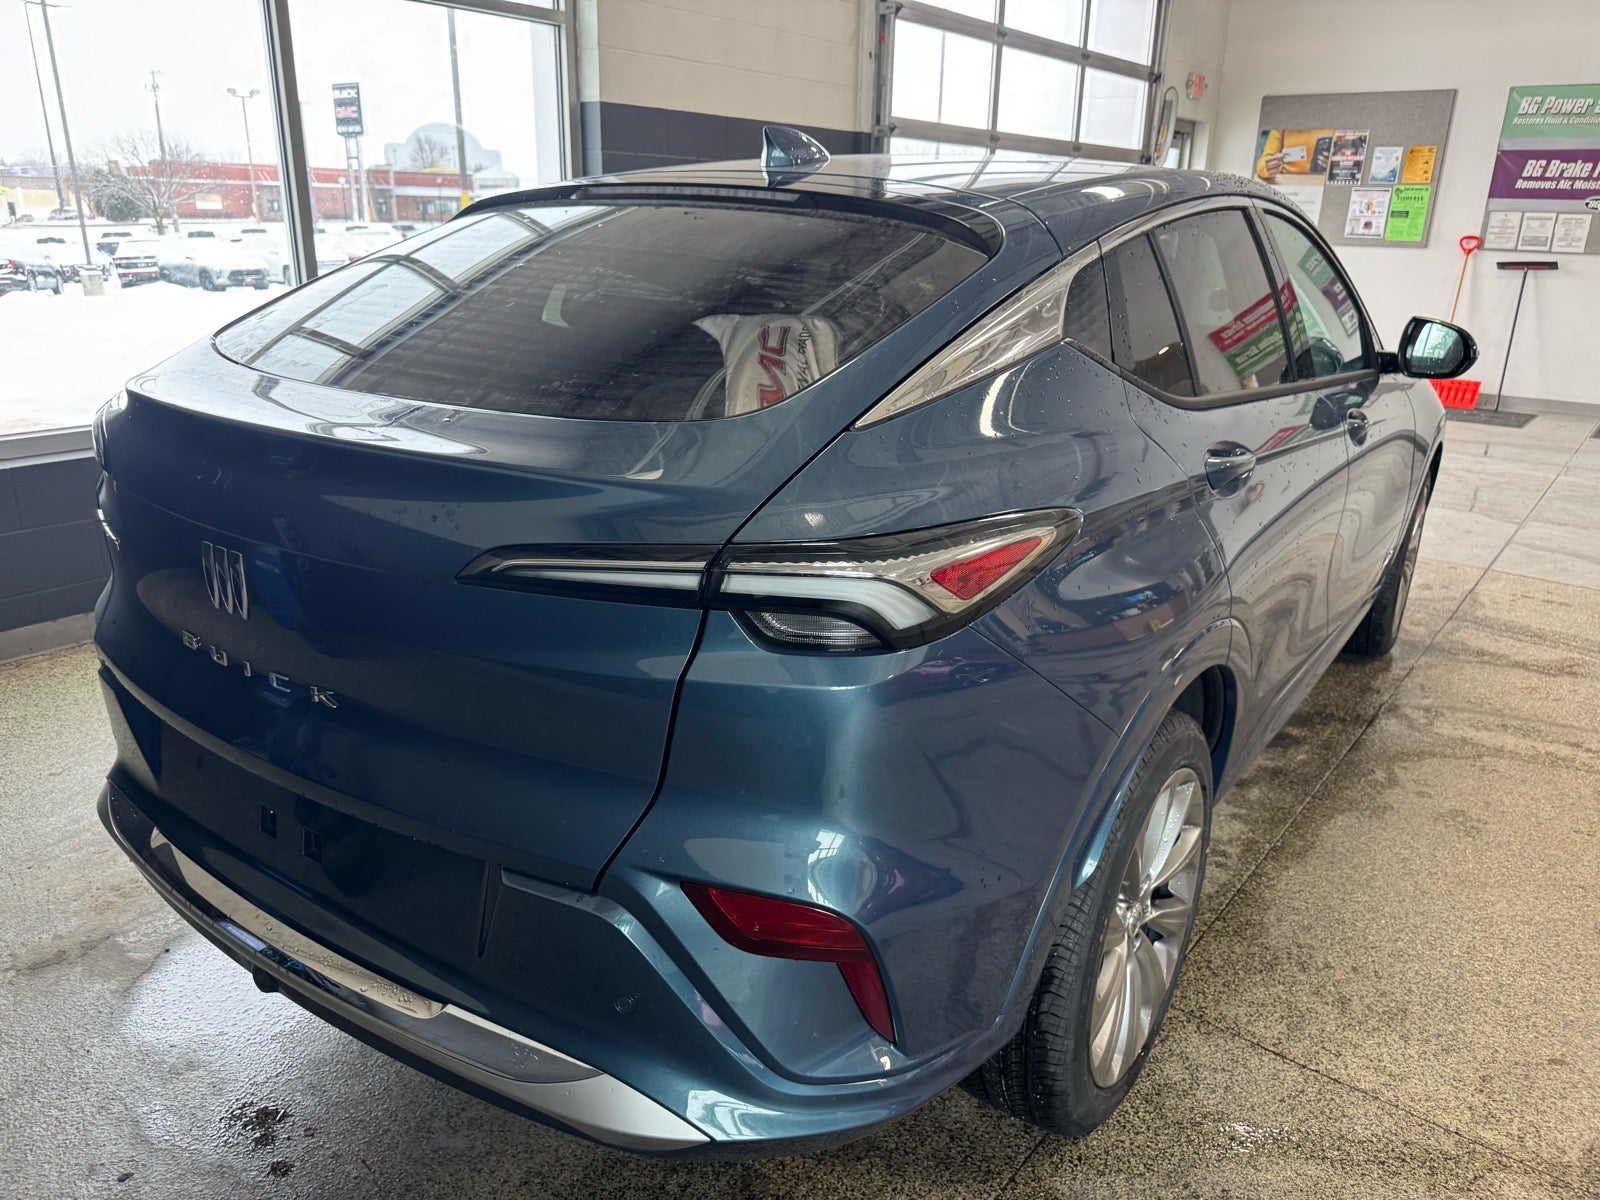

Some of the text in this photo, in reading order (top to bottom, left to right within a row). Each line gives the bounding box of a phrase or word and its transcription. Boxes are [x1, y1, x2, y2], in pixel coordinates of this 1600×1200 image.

[1518, 96, 1543, 115] BG
[1541, 95, 1594, 115] Power
[1521, 159, 1547, 178] BG
[1545, 159, 1594, 178] Brake
[1514, 179, 1558, 190] Removes
[182, 630, 339, 708] BUICK
